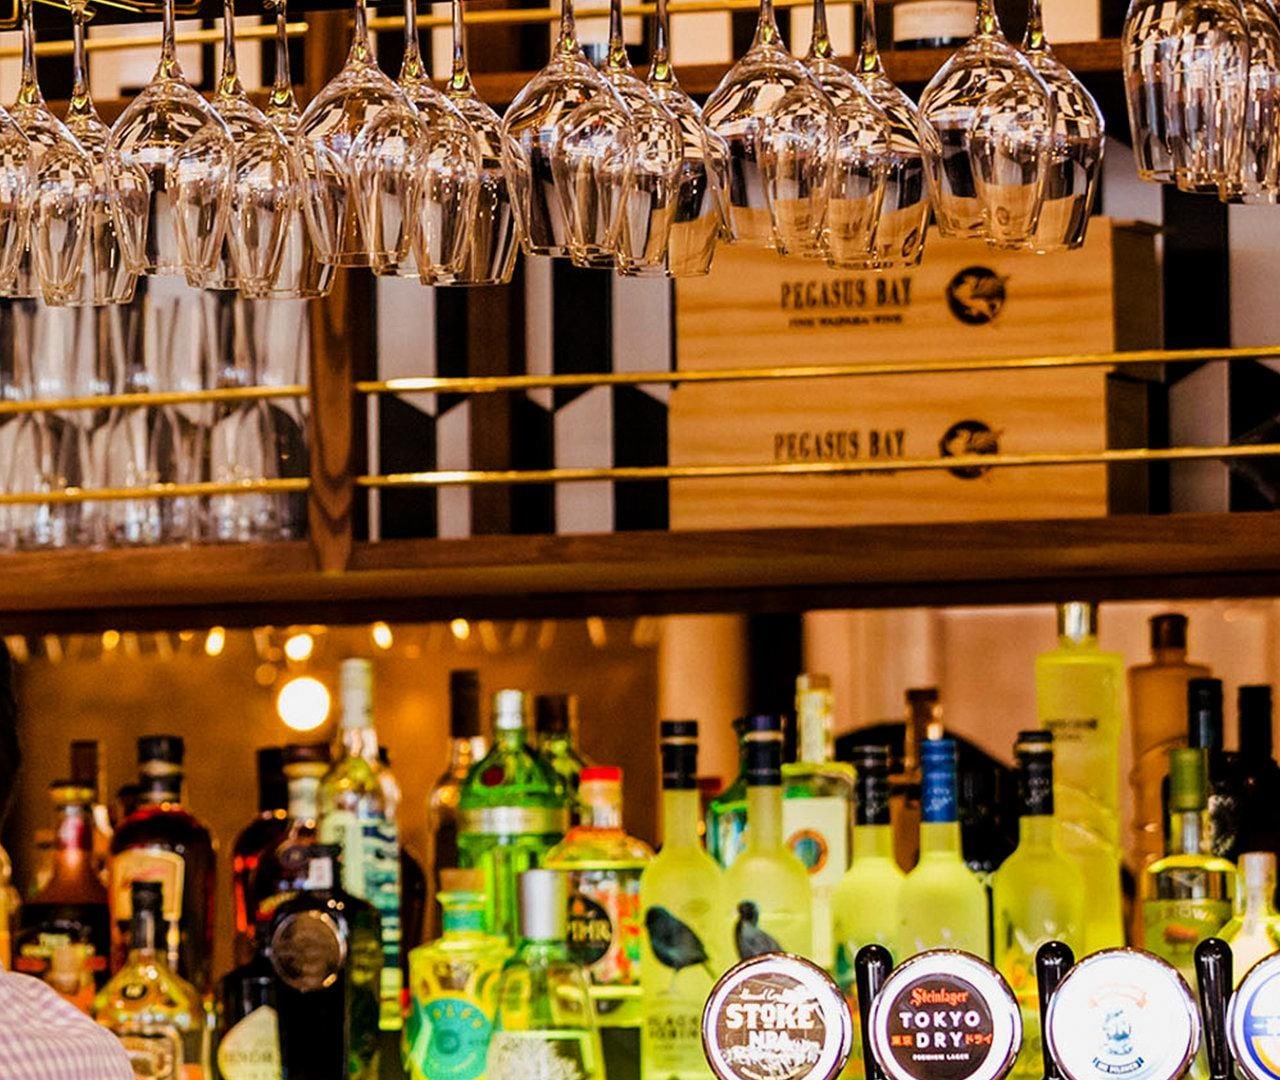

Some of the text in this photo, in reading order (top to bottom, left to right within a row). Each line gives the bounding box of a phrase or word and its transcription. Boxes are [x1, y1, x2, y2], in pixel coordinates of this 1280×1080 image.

[780, 277, 912, 310] PEGASUS BAY
[773, 428, 905, 461] PEGASUS BAY
[910, 987, 969, 1007] Steinlager
[725, 1003, 816, 1029] STOKE
[899, 1010, 981, 1029] TOKYO
[916, 1031, 963, 1048] DRY
